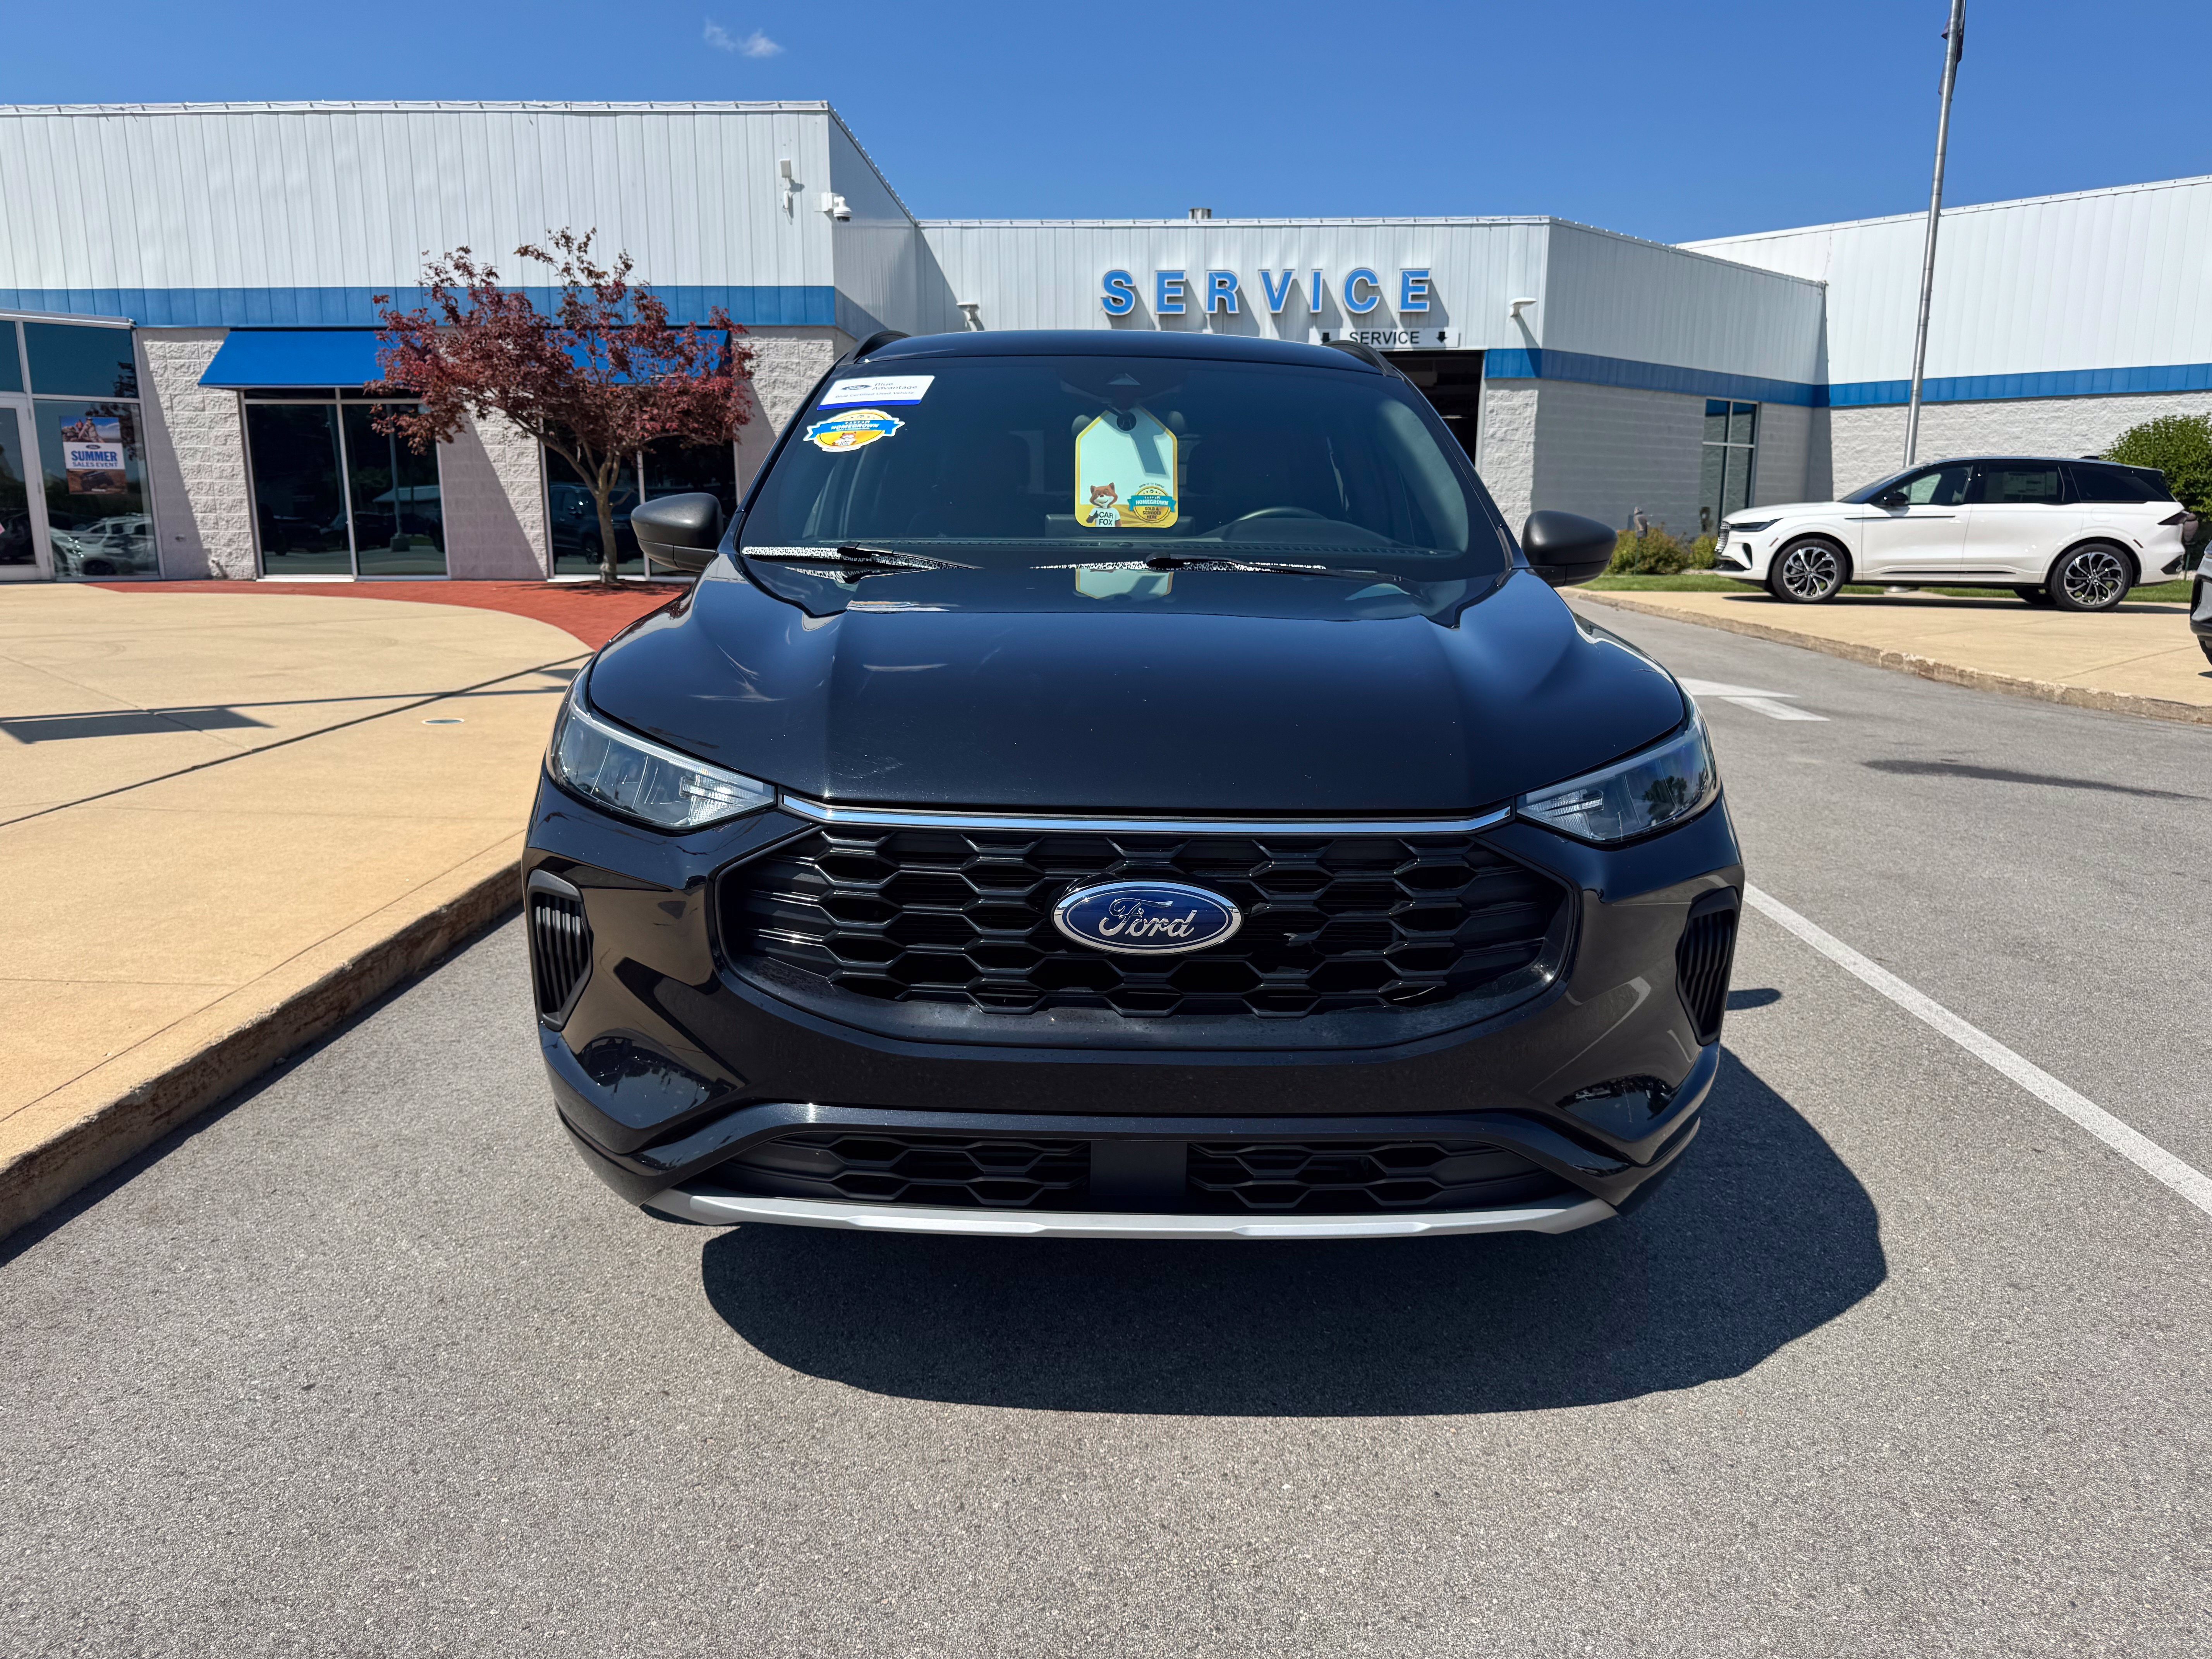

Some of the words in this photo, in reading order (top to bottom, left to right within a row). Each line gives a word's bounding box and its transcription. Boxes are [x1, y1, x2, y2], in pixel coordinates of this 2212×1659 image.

[1101, 268, 1431, 316] SERVICE
[1350, 331, 1420, 345] SERVICE
[71, 450, 117, 461] SUMMER
[1099, 898, 1197, 937] Ford
